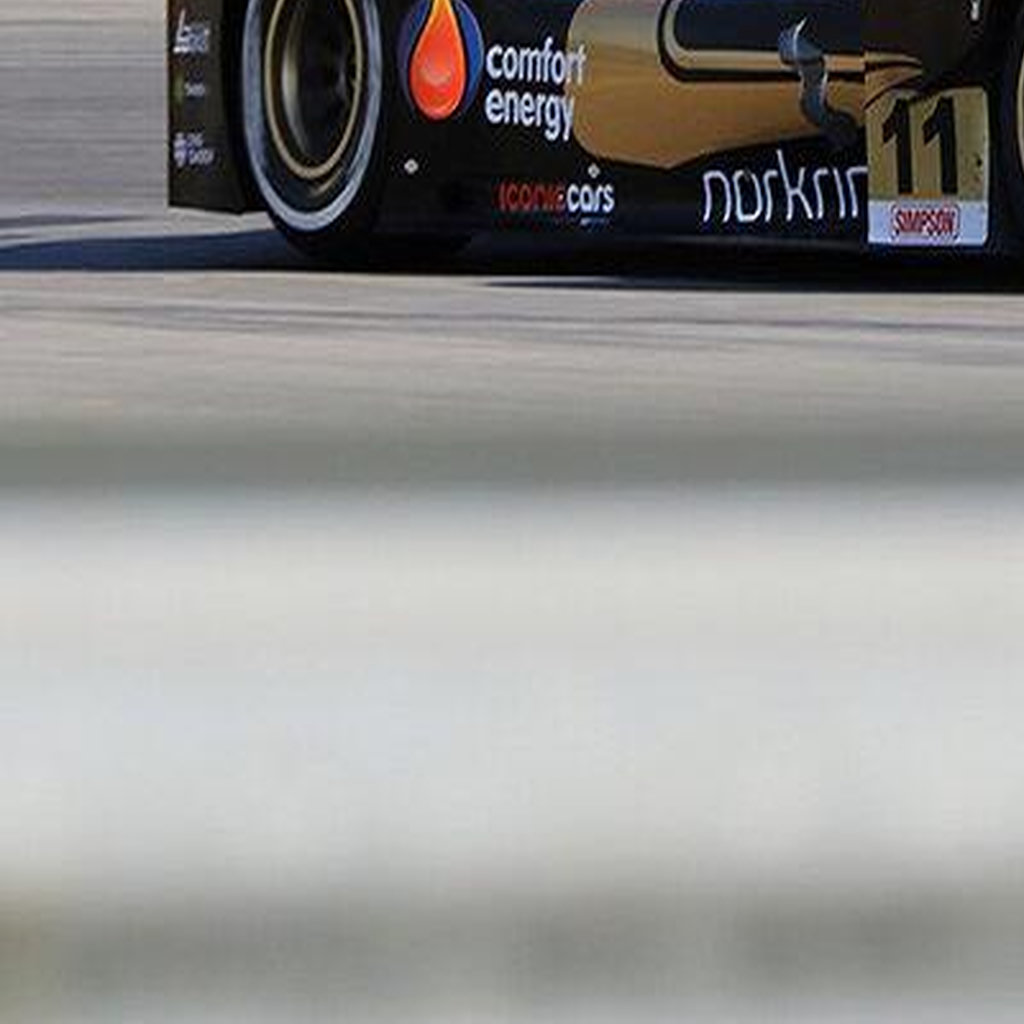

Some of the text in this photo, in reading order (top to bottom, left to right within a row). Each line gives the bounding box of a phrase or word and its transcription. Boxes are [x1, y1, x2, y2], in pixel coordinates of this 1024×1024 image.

[486, 37, 586, 85] comfort
[485, 89, 575, 141] energy
[881, 96, 958, 195] 11
[895, 208, 954, 236] SIMPSON
